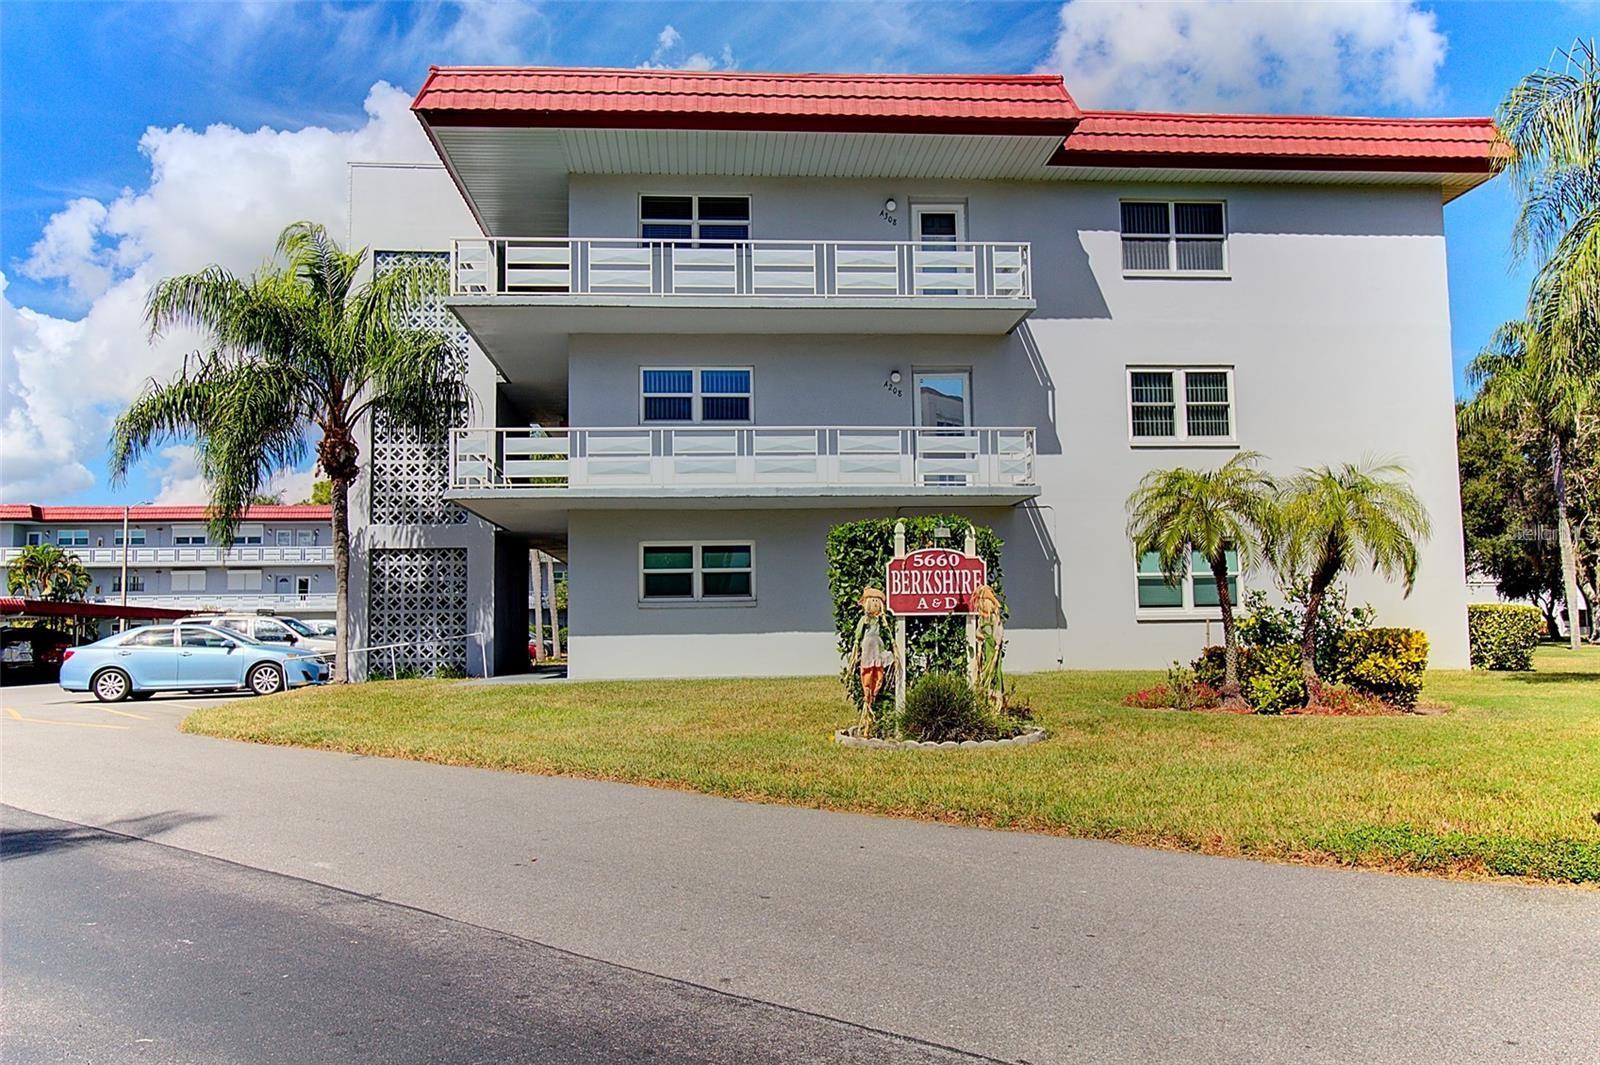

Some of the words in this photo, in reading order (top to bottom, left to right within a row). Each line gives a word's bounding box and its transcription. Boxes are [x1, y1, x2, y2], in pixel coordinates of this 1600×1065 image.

[879, 209, 897, 226] A308
[883, 380, 902, 398] A208
[913, 554, 960, 567] 5660
[917, 597, 928, 609] A
[931, 598, 941, 608] &
[945, 597, 957, 609] D
